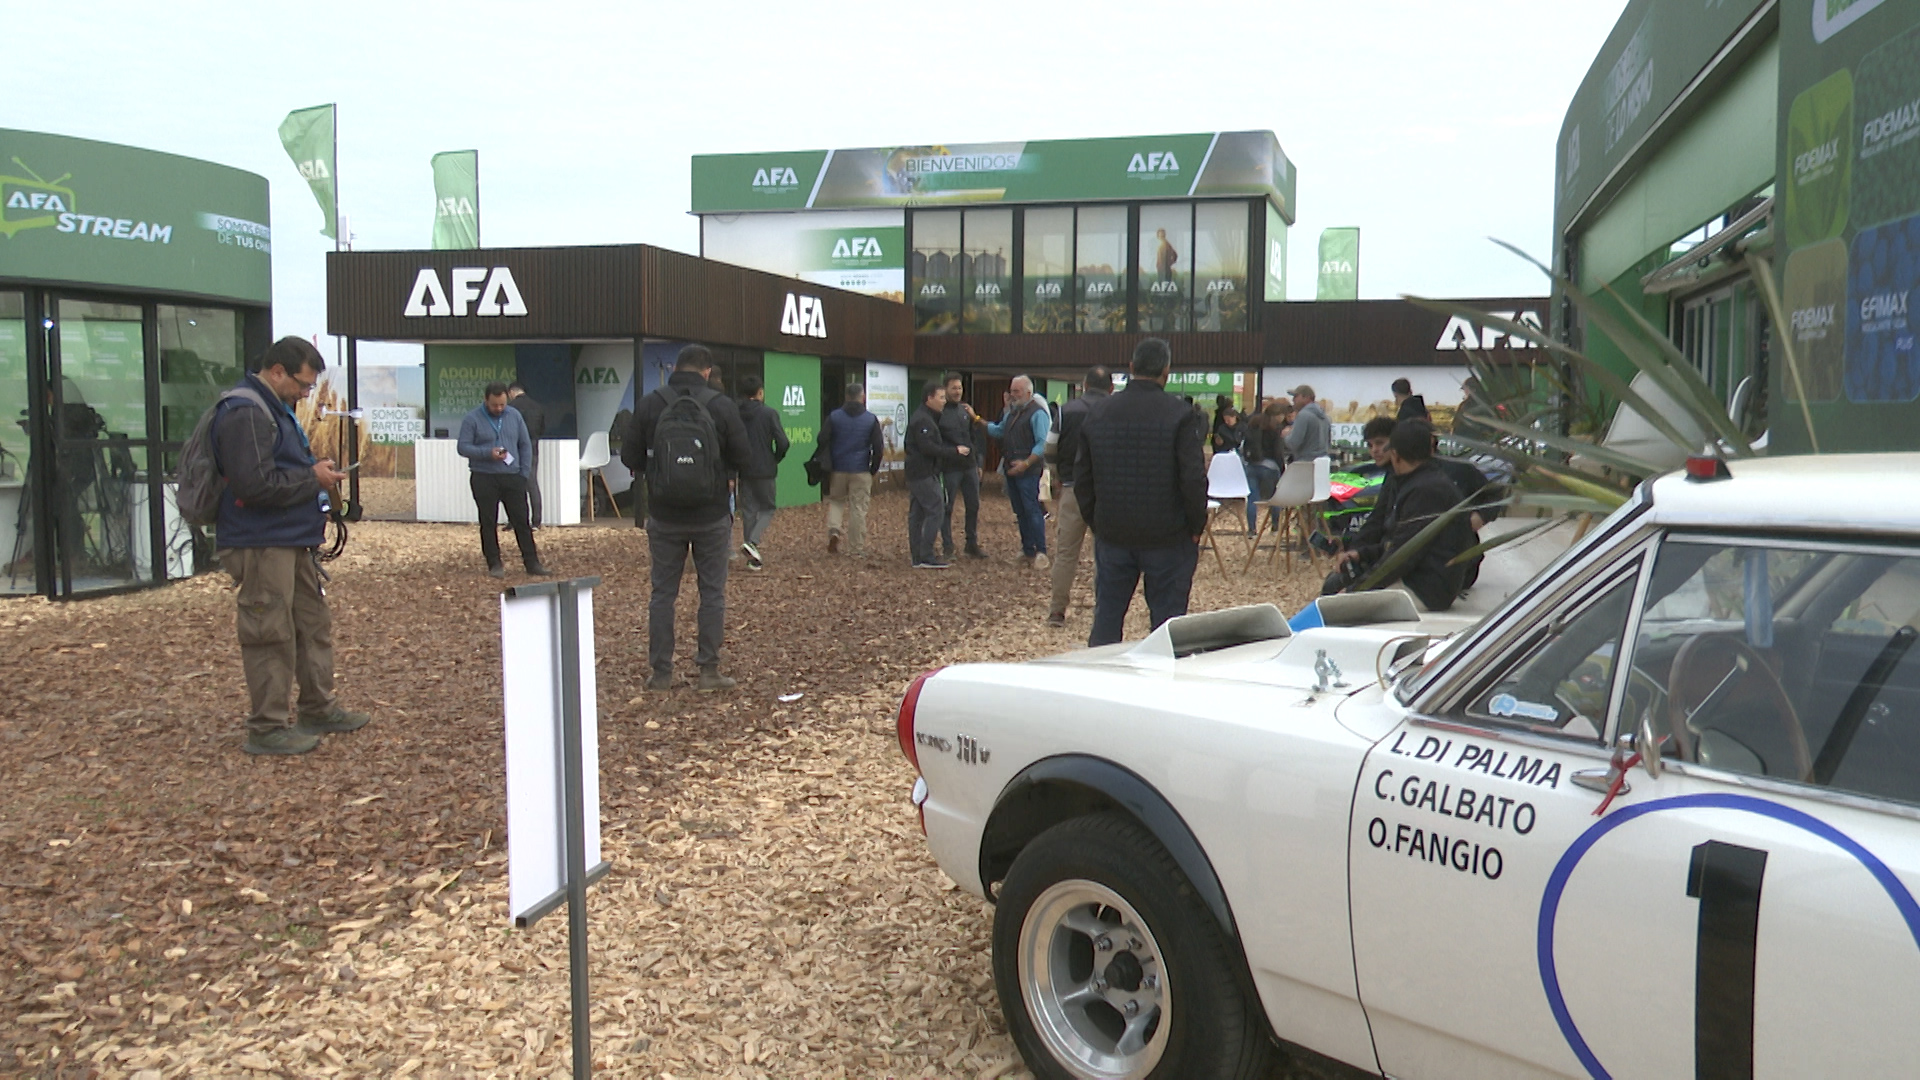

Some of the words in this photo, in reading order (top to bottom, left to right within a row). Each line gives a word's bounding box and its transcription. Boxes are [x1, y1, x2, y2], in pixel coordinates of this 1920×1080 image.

[905, 155, 1016, 172] BIENVENIDOS
[1127, 152, 1180, 172] AFA
[752, 167, 798, 187] AFA
[7, 191, 66, 212] AFA
[57, 212, 173, 244] STREAM
[235, 235, 254, 248] TUS
[832, 237, 883, 258] AFA
[404, 266, 528, 317] AFA
[921, 283, 946, 294] AFA
[975, 283, 1001, 294] AFA
[1035, 283, 1062, 294] AFA
[1087, 282, 1114, 293] AFA
[1151, 281, 1178, 292] AFA
[1206, 280, 1235, 291] AFA
[780, 293, 827, 339] AFA
[440, 364, 496, 380] ADQUIRÍ
[576, 367, 620, 384] AFA
[782, 385, 805, 406] AFA
[371, 409, 409, 420] SOMOS
[371, 421, 404, 432] PARTE
[407, 421, 421, 432] DE
[371, 433, 386, 442] LO
[1453, 743, 1563, 790] PALMA
[1373, 769, 1537, 835] C.GALBATO
[1367, 816, 1504, 881] O.FANGIO
[1686, 838, 1769, 1080] 1
